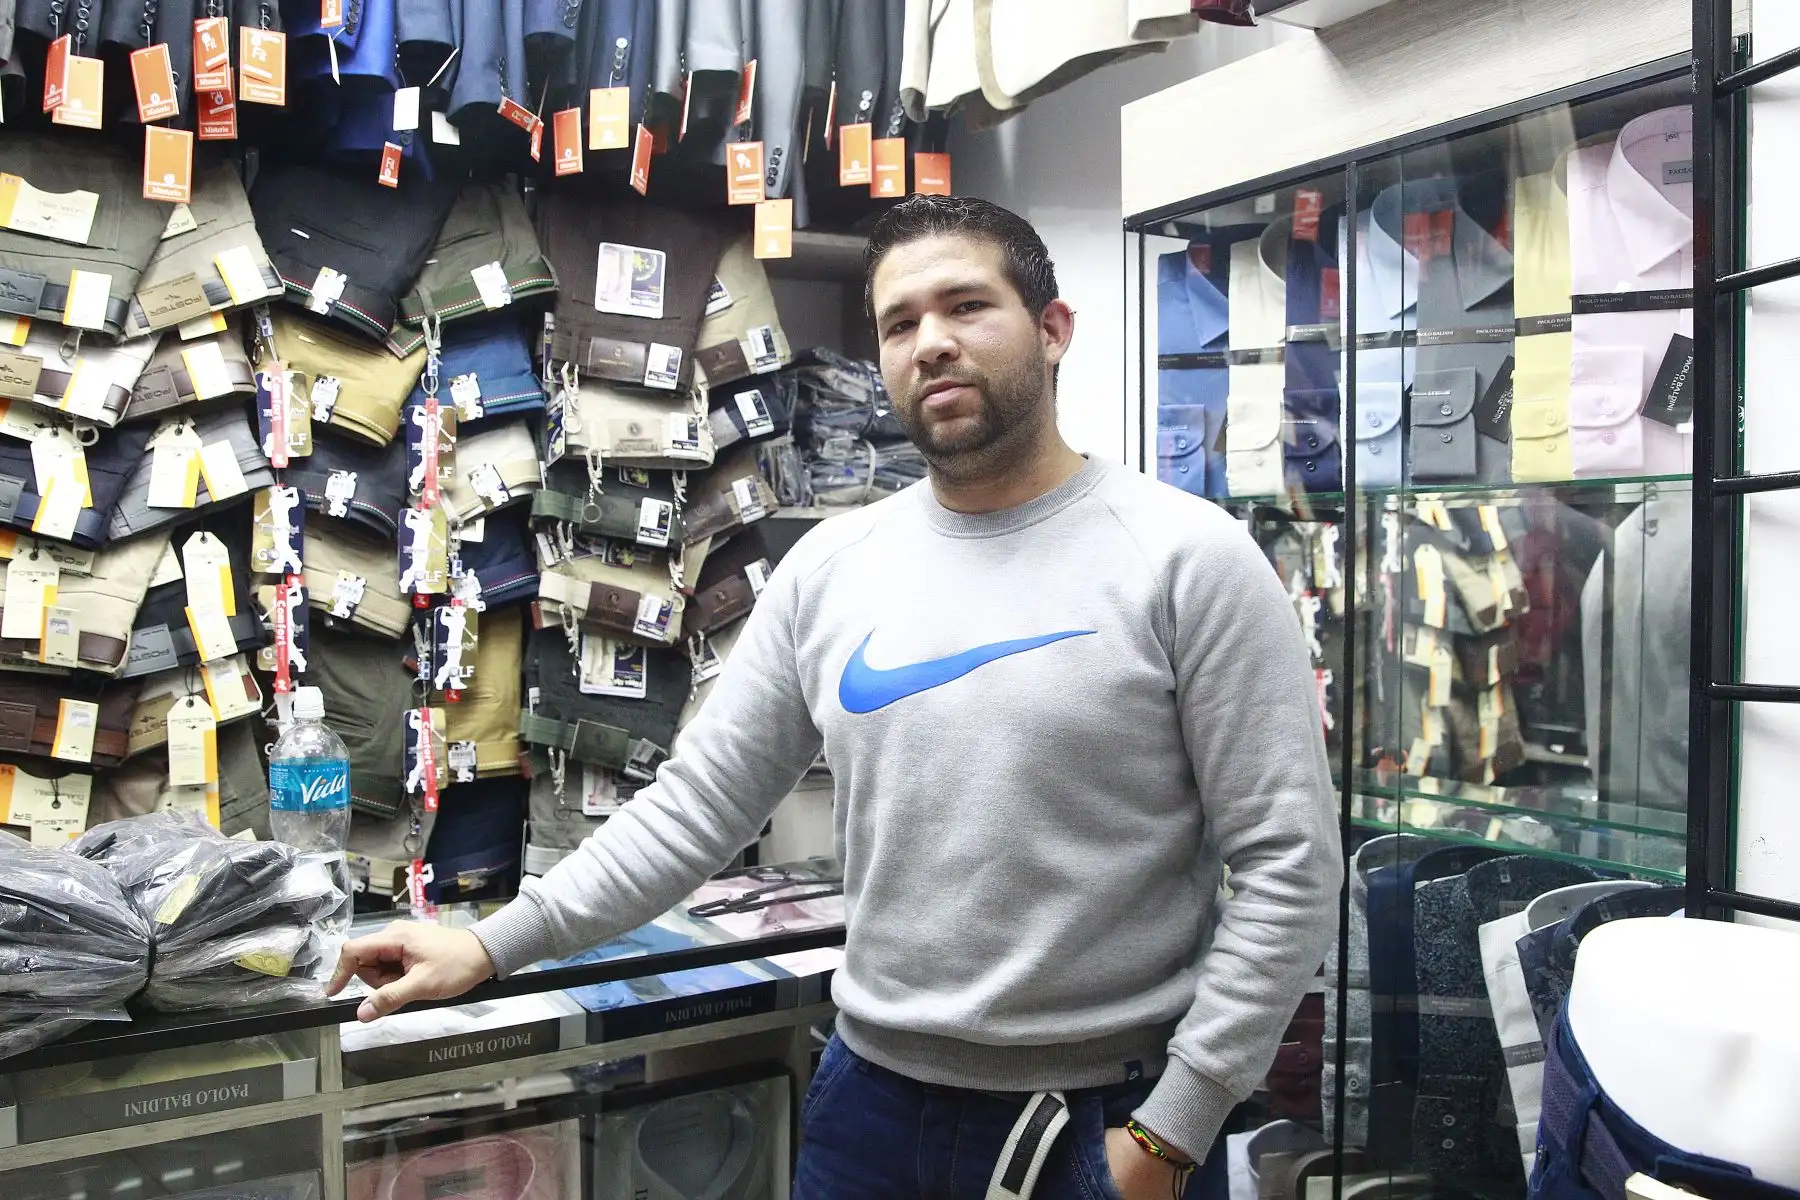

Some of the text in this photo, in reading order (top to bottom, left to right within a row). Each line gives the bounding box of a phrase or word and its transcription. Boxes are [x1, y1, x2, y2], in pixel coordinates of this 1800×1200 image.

[204, 125, 229, 135] Misterio
[150, 295, 203, 316] FOSTER
[271, 375, 283, 422] Comfort
[1666, 355, 1693, 412] PAOLO BALDINI
[426, 412, 438, 458] Comfort
[12, 569, 56, 577] FOSTER
[276, 600, 287, 646] Comfort
[421, 719, 434, 766] Comfort
[300, 773, 347, 805] Vida
[34, 818, 79, 826] FOSTER
[665, 996, 752, 1023] PAOLO BALDINI
[428, 1032, 531, 1063] PAOLO BALDINI
[124, 1083, 249, 1117] PAOLO BALDINI
